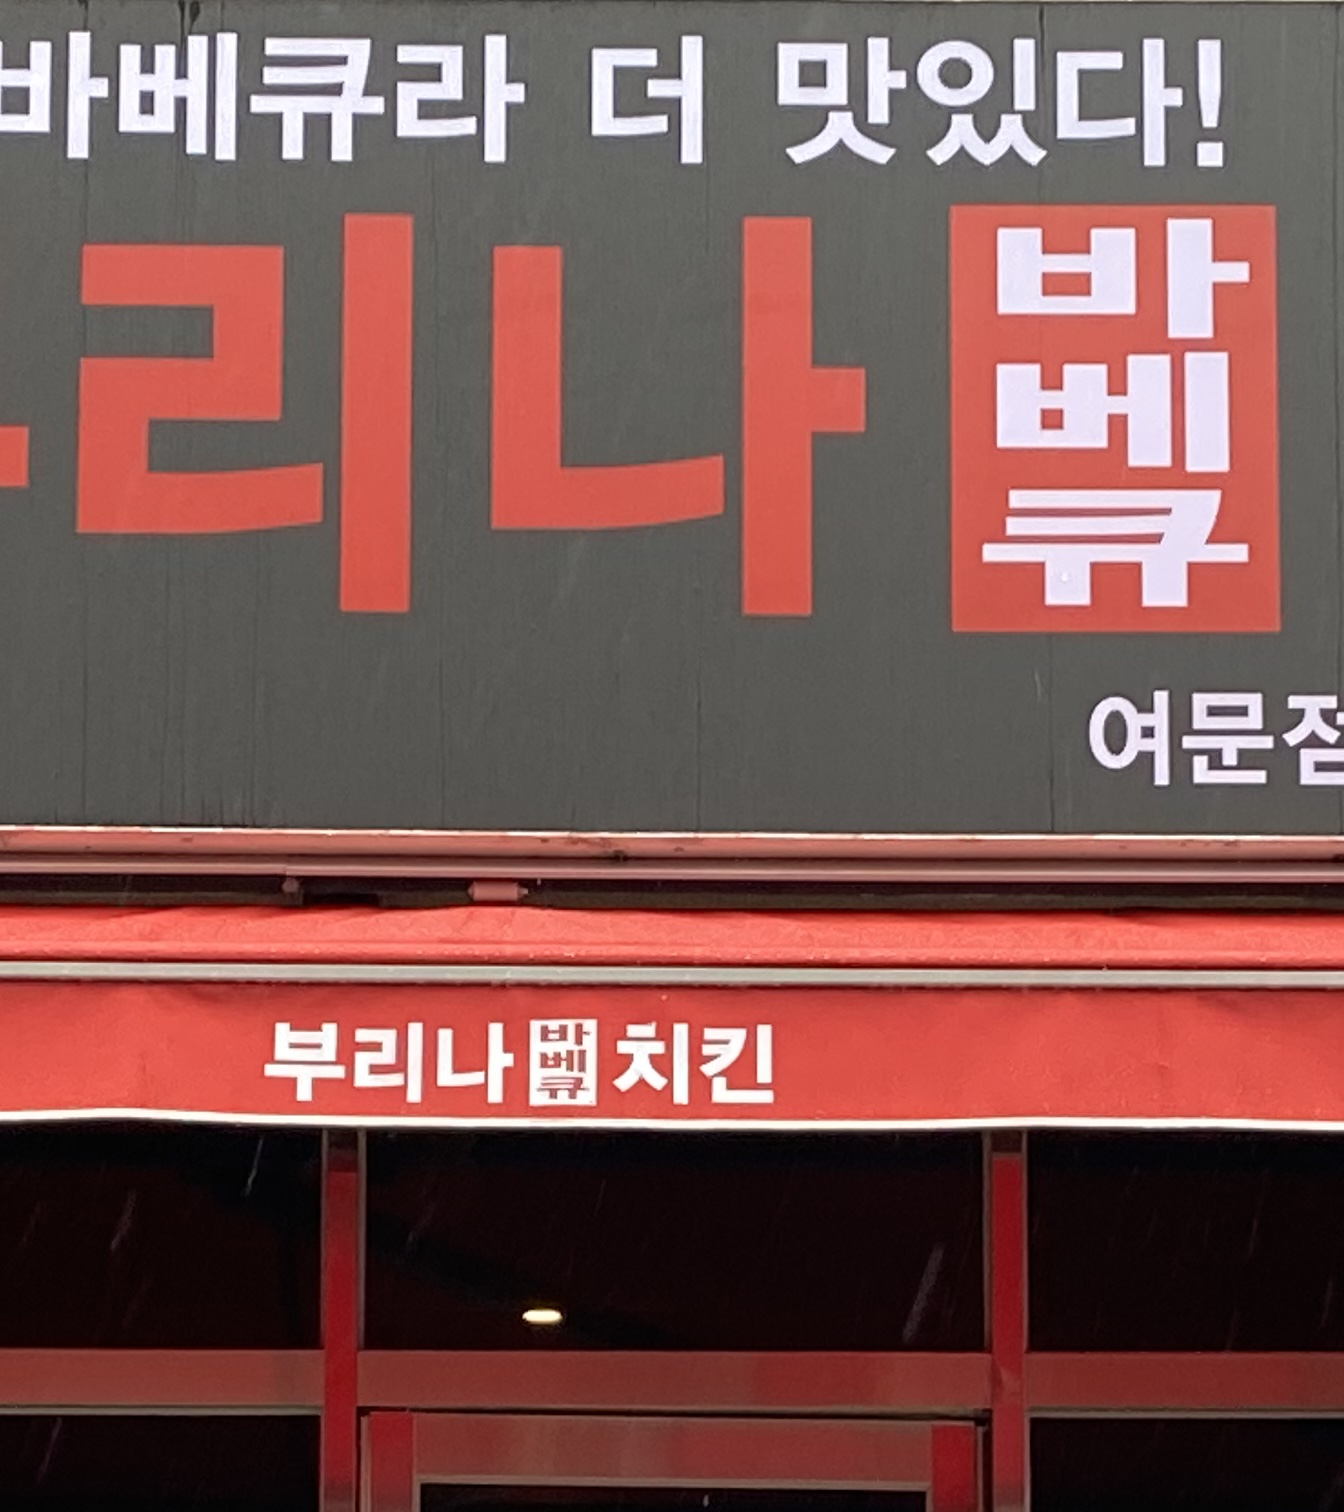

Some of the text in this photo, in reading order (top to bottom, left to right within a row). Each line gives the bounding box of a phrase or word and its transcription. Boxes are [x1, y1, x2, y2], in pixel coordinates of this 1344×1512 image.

[591, 35, 704, 165] 더
[777, 36, 1224, 168] 맛있다!
[982, 217, 1250, 608] 바베큐
[263, 1022, 774, 1105] 부리나 바베큐 치킨
